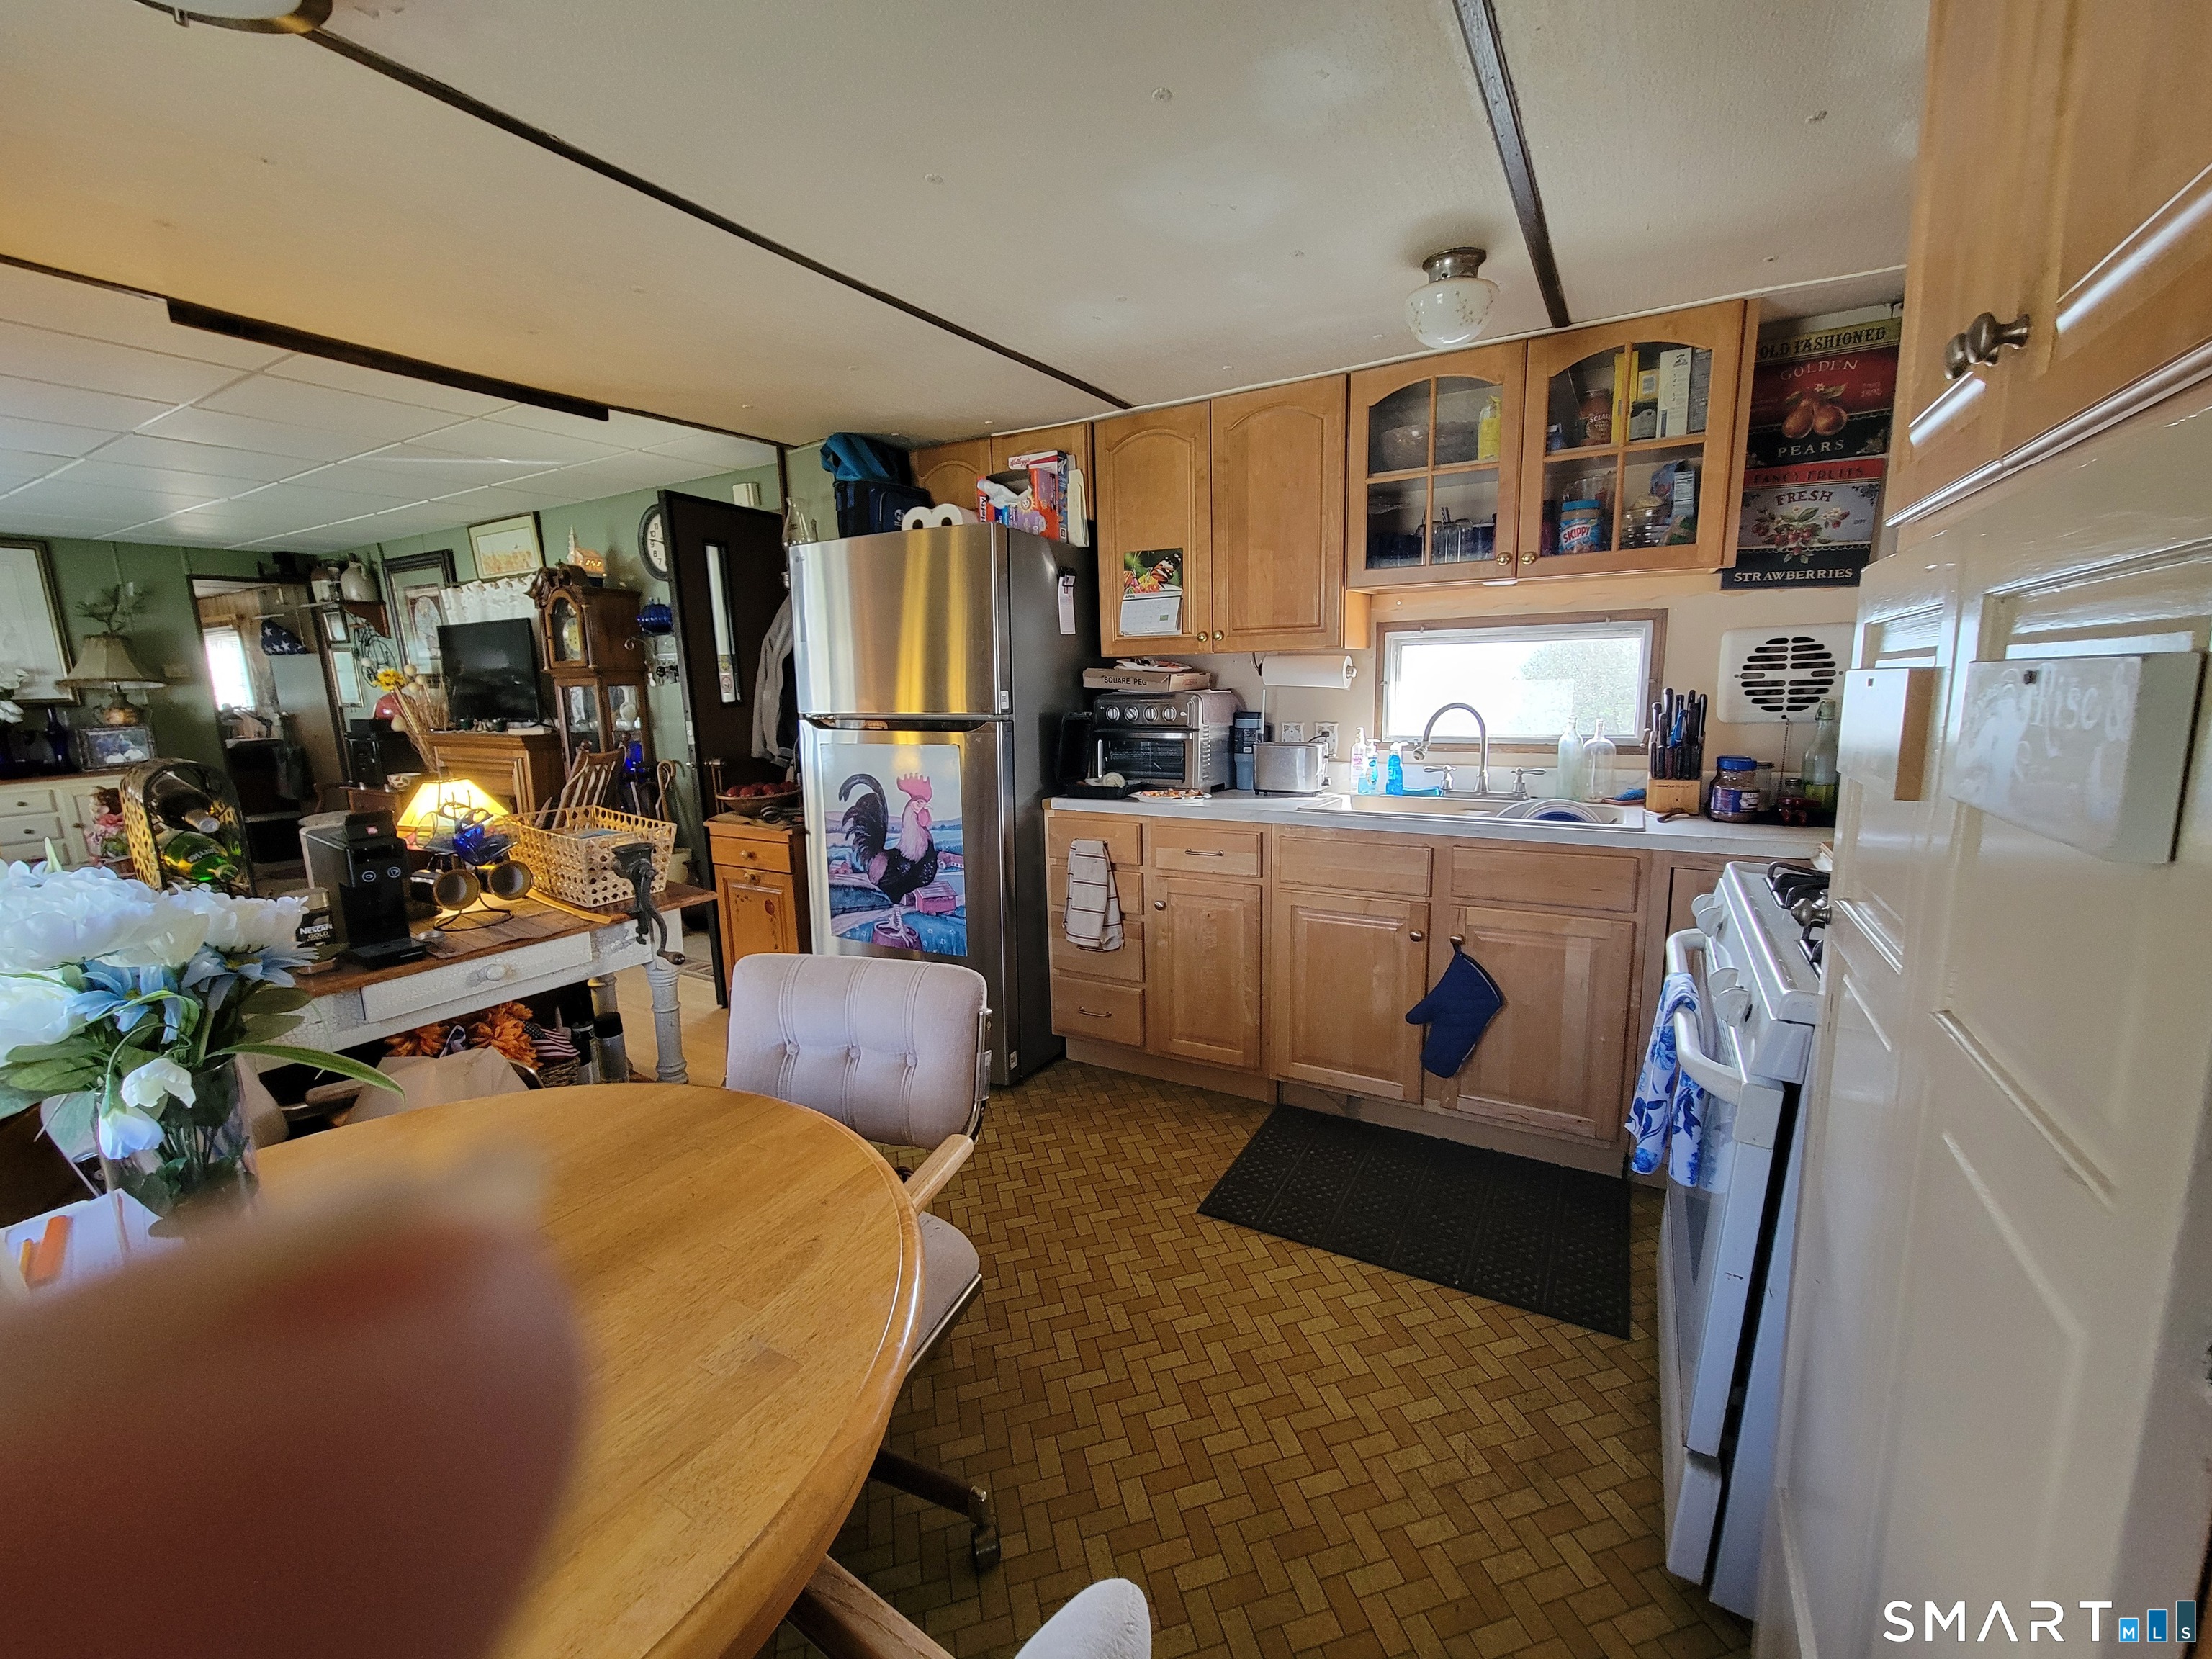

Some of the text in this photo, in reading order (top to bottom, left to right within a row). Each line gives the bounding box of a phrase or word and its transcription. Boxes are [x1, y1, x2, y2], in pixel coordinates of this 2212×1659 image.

[1759, 326, 1886, 359] OLD FASHIONED
[1780, 360, 1858, 380] GOLDEN
[1777, 440, 1844, 458] PEARS
[1775, 490, 1834, 506] FRESH
[1563, 526, 1590, 544] SKIPPY
[1734, 568, 1853, 583] STRAWBERRIES
[1104, 676, 1130, 685] SQUARE
[307, 930, 328, 939] GOLD
